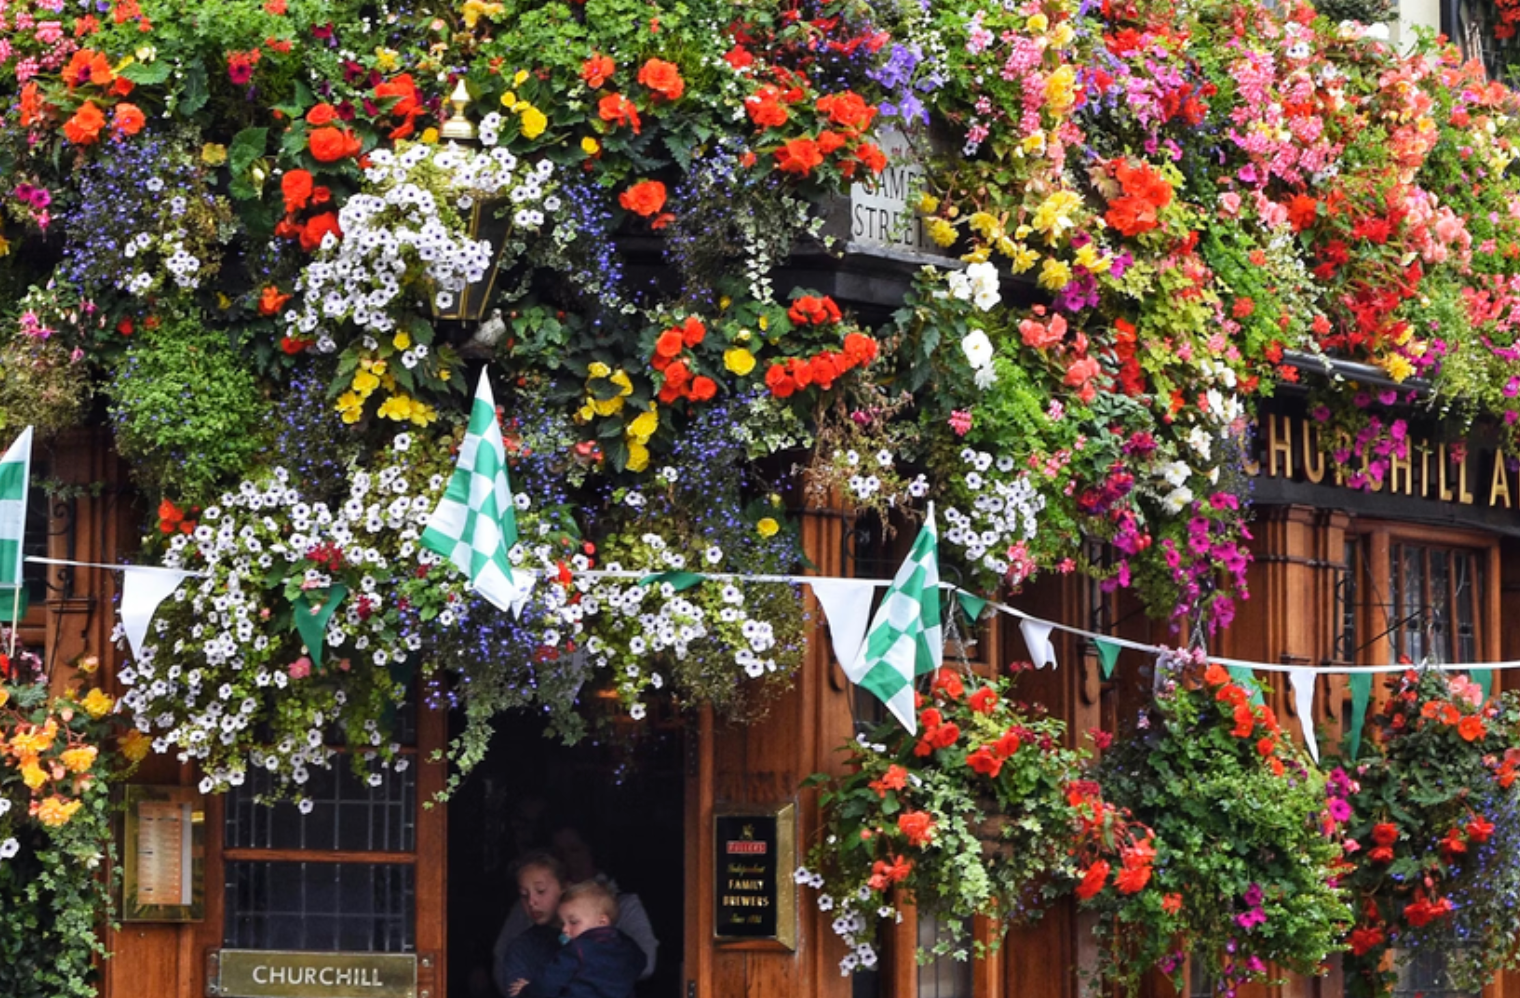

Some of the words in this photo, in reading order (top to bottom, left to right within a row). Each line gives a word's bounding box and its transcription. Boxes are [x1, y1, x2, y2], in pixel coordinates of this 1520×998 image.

[728, 879, 764, 891] FAMILY
[722, 895, 770, 907] BREWERS
[251, 964, 384, 987] CHURCHILL
